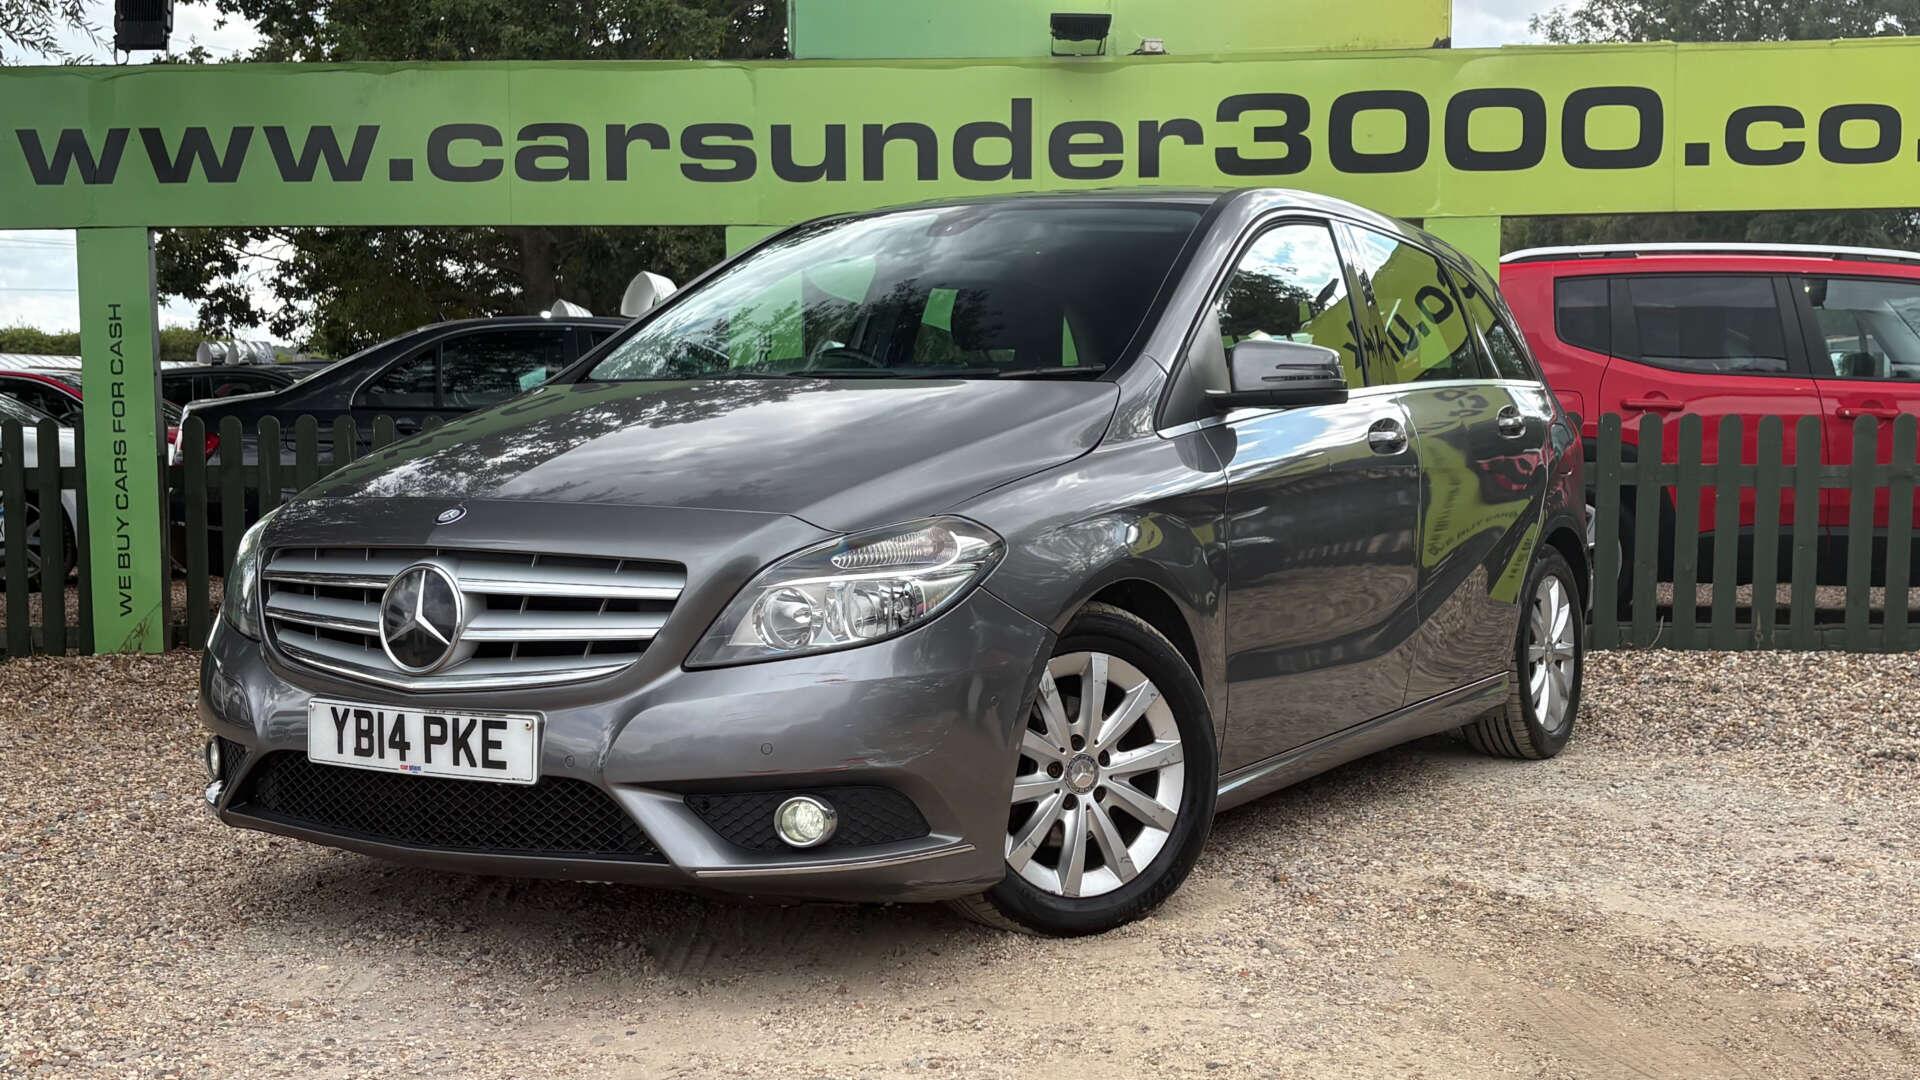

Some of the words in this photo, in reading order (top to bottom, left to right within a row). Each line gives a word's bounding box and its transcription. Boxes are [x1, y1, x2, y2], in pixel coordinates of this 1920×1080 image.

[14, 86, 1920, 186] www.carsunder3000.co
[107, 303, 124, 376] CASH
[111, 381, 126, 433] FOR
[113, 439, 129, 511] CARS
[116, 515, 131, 569] BUY
[118, 575, 133, 618] WE
[330, 706, 411, 762] YB14
[423, 715, 508, 771] PKE
